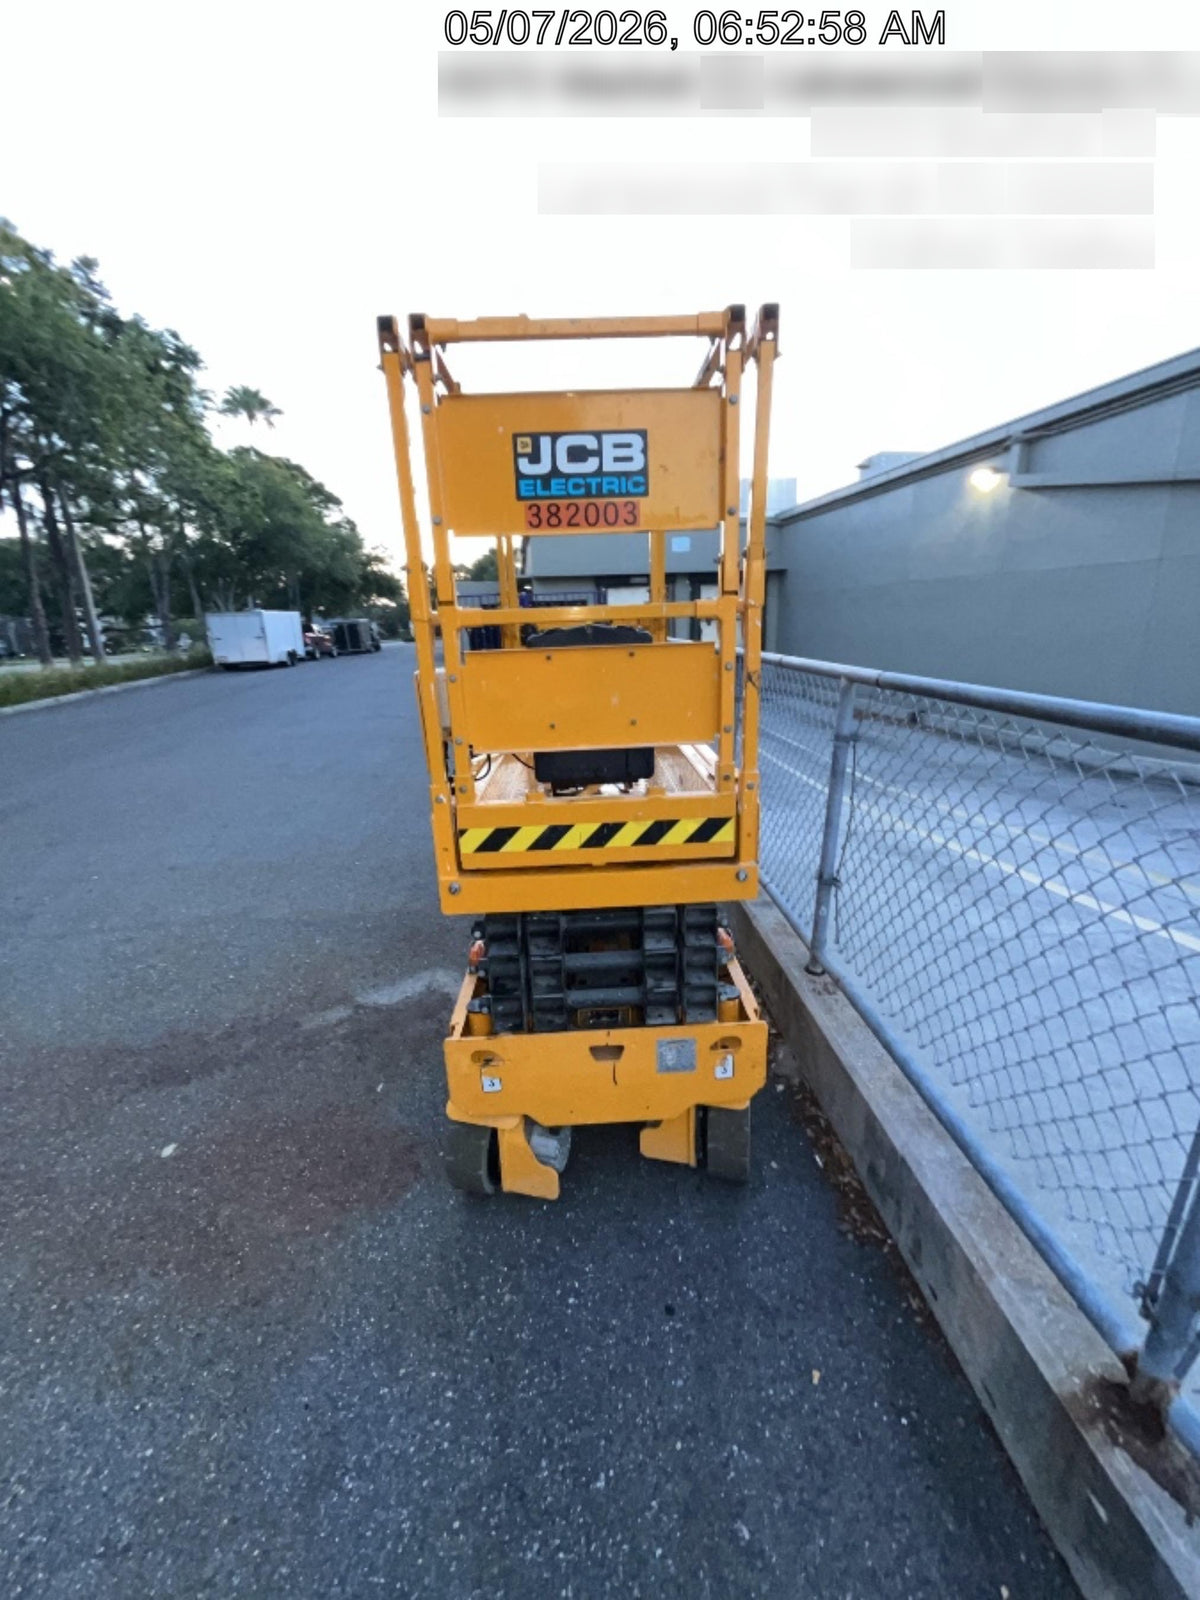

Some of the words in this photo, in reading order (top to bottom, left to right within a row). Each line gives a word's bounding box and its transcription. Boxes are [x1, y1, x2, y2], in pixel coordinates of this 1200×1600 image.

[517, 433, 646, 476] JCB
[518, 475, 646, 497] ELECTRIC
[527, 501, 638, 528] 382003
